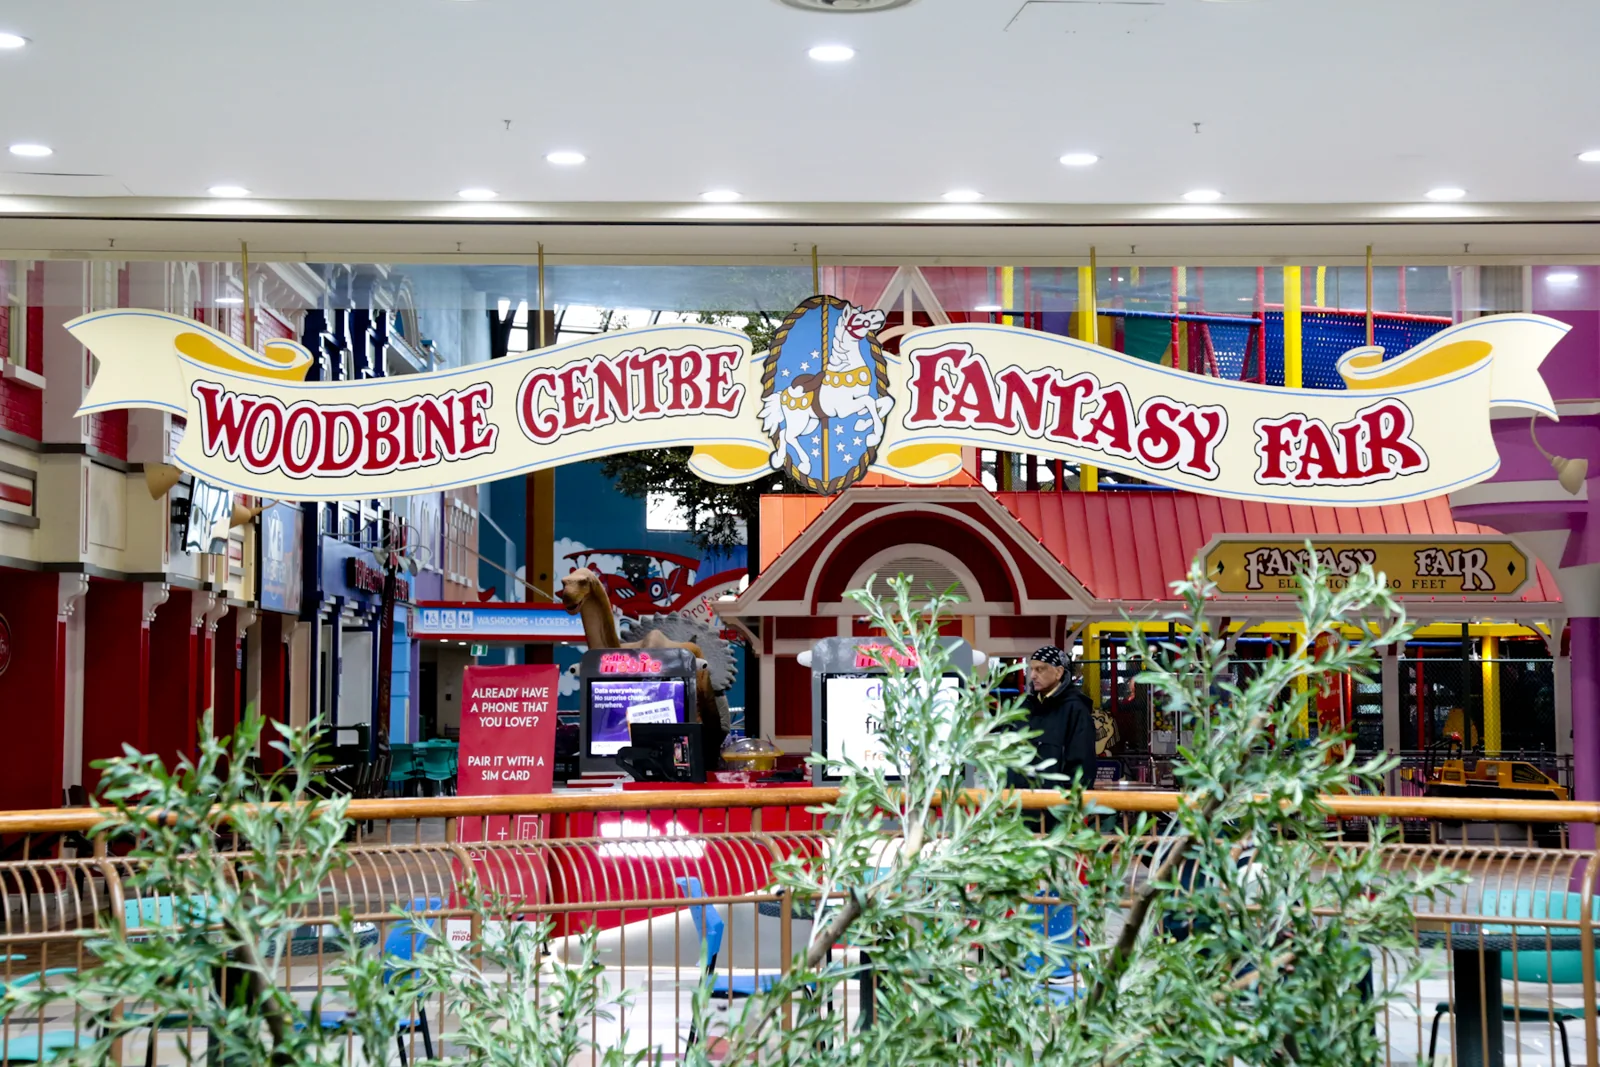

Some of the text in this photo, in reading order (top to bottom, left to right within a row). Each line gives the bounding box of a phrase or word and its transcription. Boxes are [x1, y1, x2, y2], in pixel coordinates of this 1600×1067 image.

[194, 345, 1426, 484] WOODBINE CENTRE FANTASY FAIR
[1245, 547, 1496, 591] FANTASY FAIR
[1412, 579, 1446, 589] FEET
[476, 616, 528, 626] WASHROOMS
[535, 617, 569, 627] LOCKERS
[600, 656, 662, 673] mobile
[471, 687, 549, 698] ALREADY HAVE
[470, 702, 549, 713] A PHONE THAT
[479, 716, 539, 727] YOU LOVE?
[468, 756, 544, 766] PAIR IT WITH A
[482, 770, 530, 780] SIM CARD
